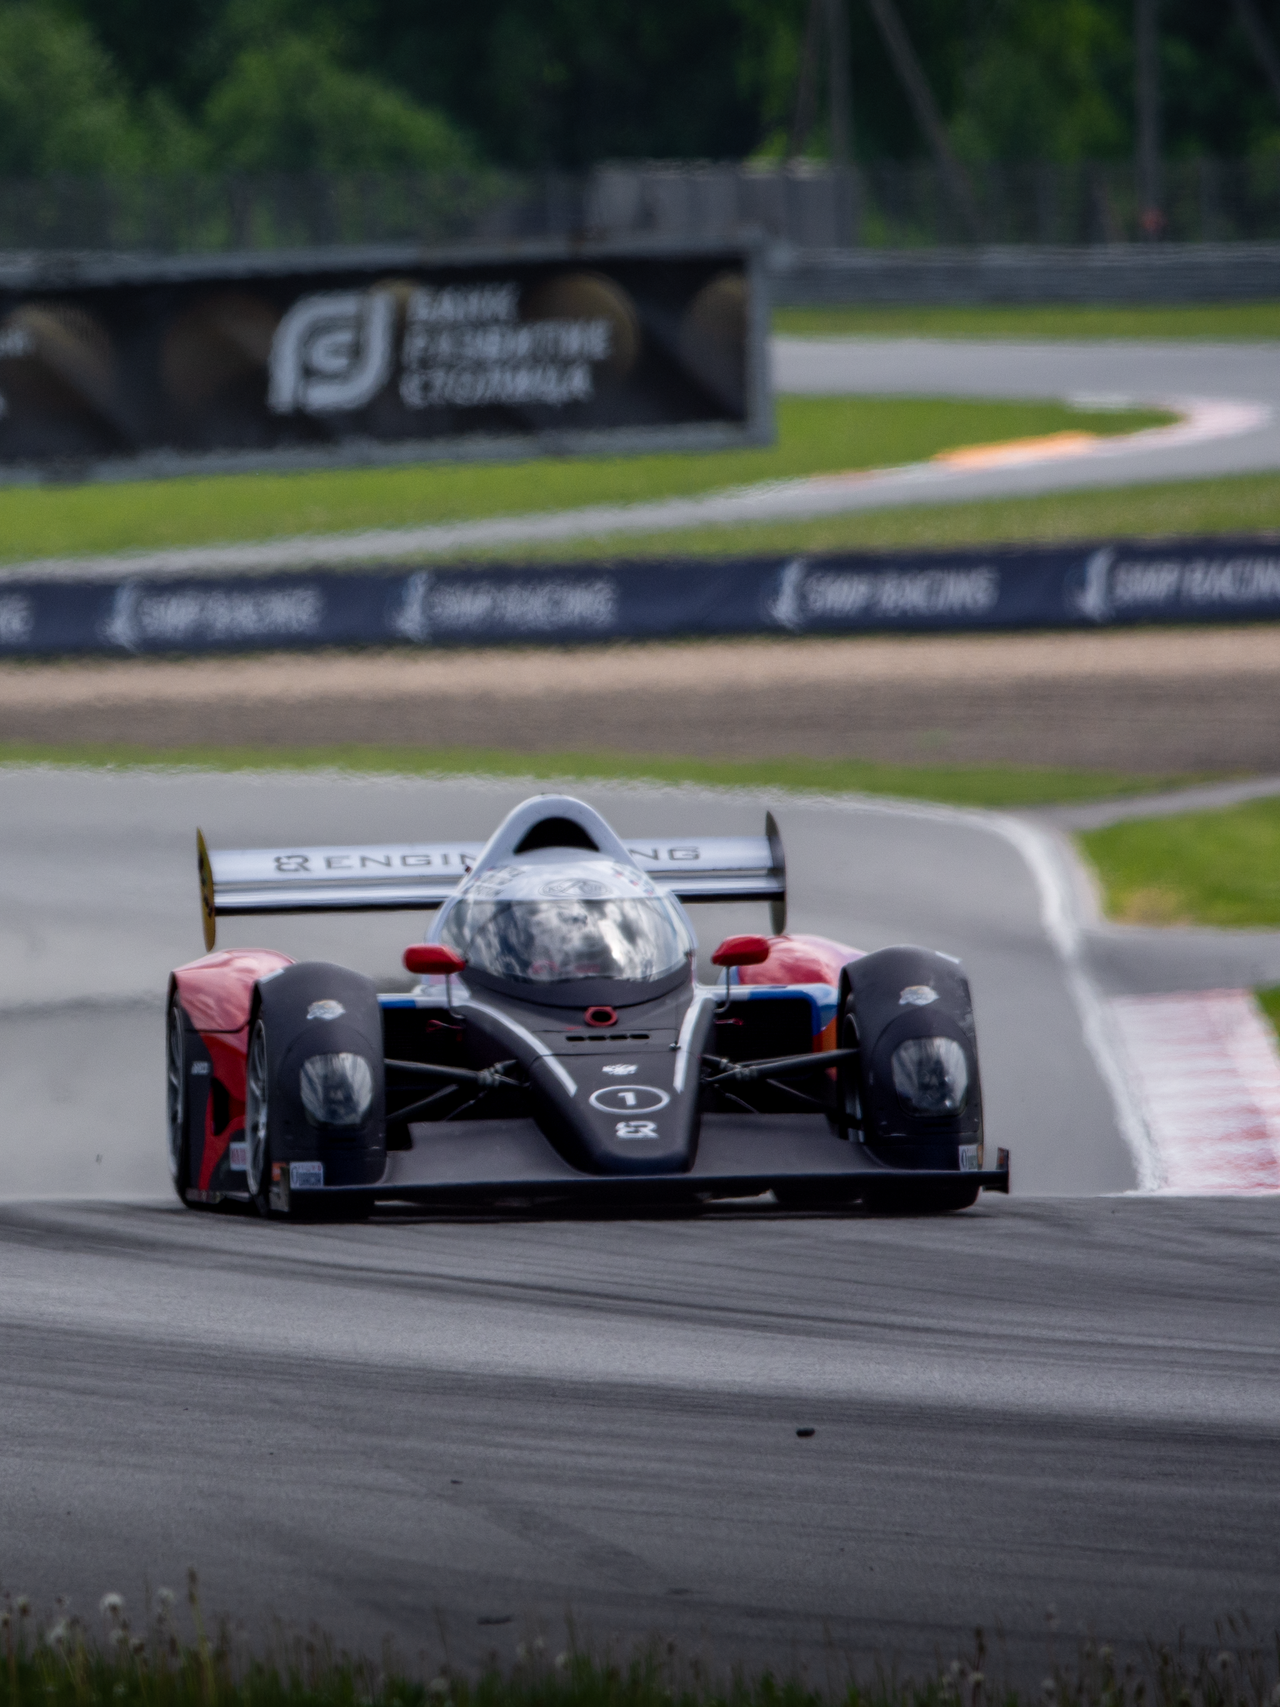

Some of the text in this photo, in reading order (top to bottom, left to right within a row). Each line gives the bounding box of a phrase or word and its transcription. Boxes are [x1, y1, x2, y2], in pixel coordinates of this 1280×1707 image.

[495, 576, 617, 629] RACING
[807, 566, 998, 617] SMP RACING
[1114, 560, 1184, 606] SMP
[208, 587, 322, 635] RACING
[617, 1091, 637, 1106] 1
